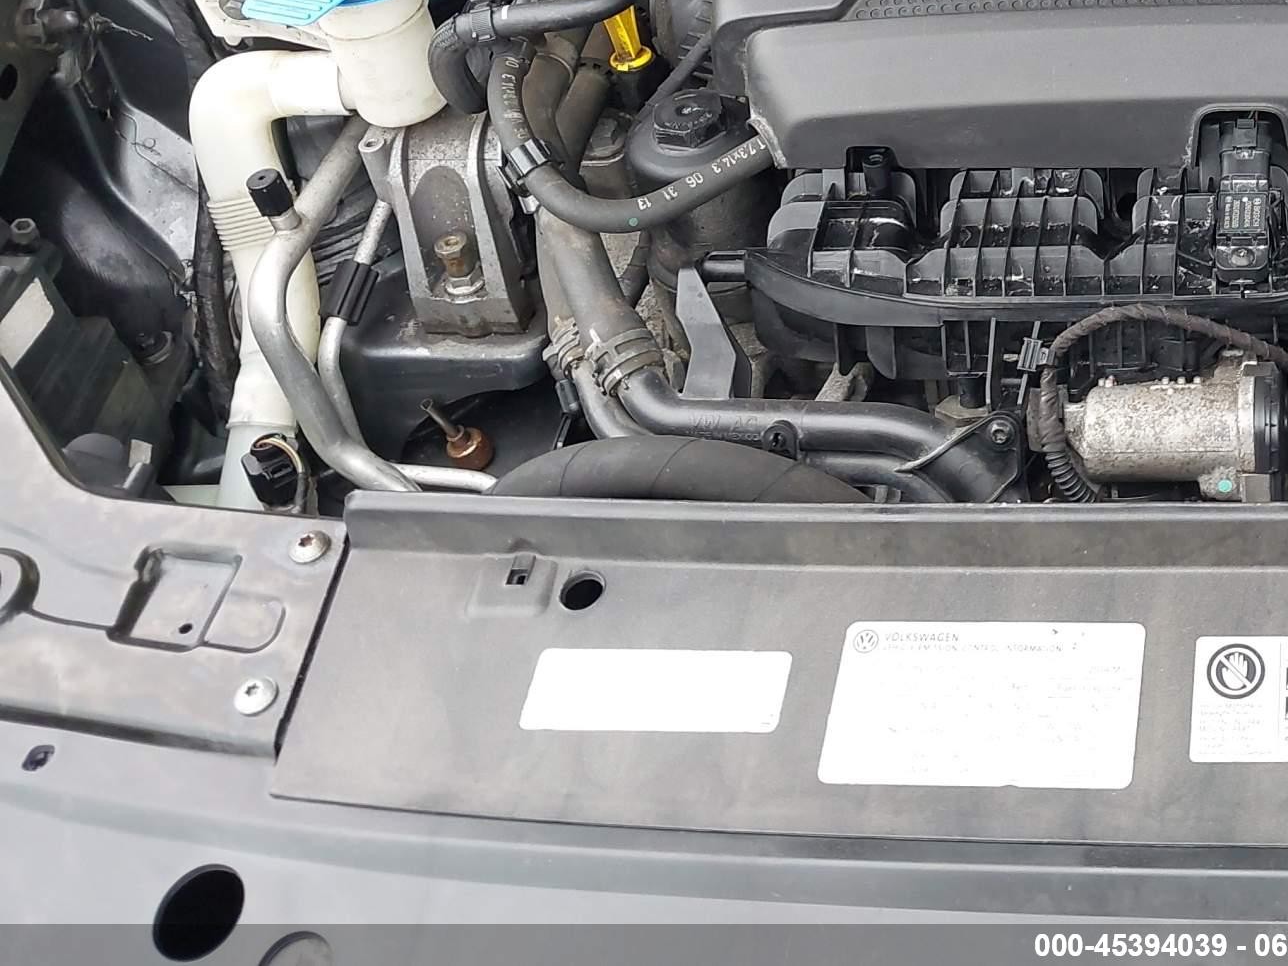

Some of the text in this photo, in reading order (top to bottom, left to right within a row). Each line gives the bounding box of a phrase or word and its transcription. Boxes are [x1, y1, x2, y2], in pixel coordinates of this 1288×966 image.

[685, 172, 704, 188] 06
[661, 186, 678, 201] 31
[637, 197, 652, 210] 13
[884, 633, 960, 642] VOLKSWAGEN
